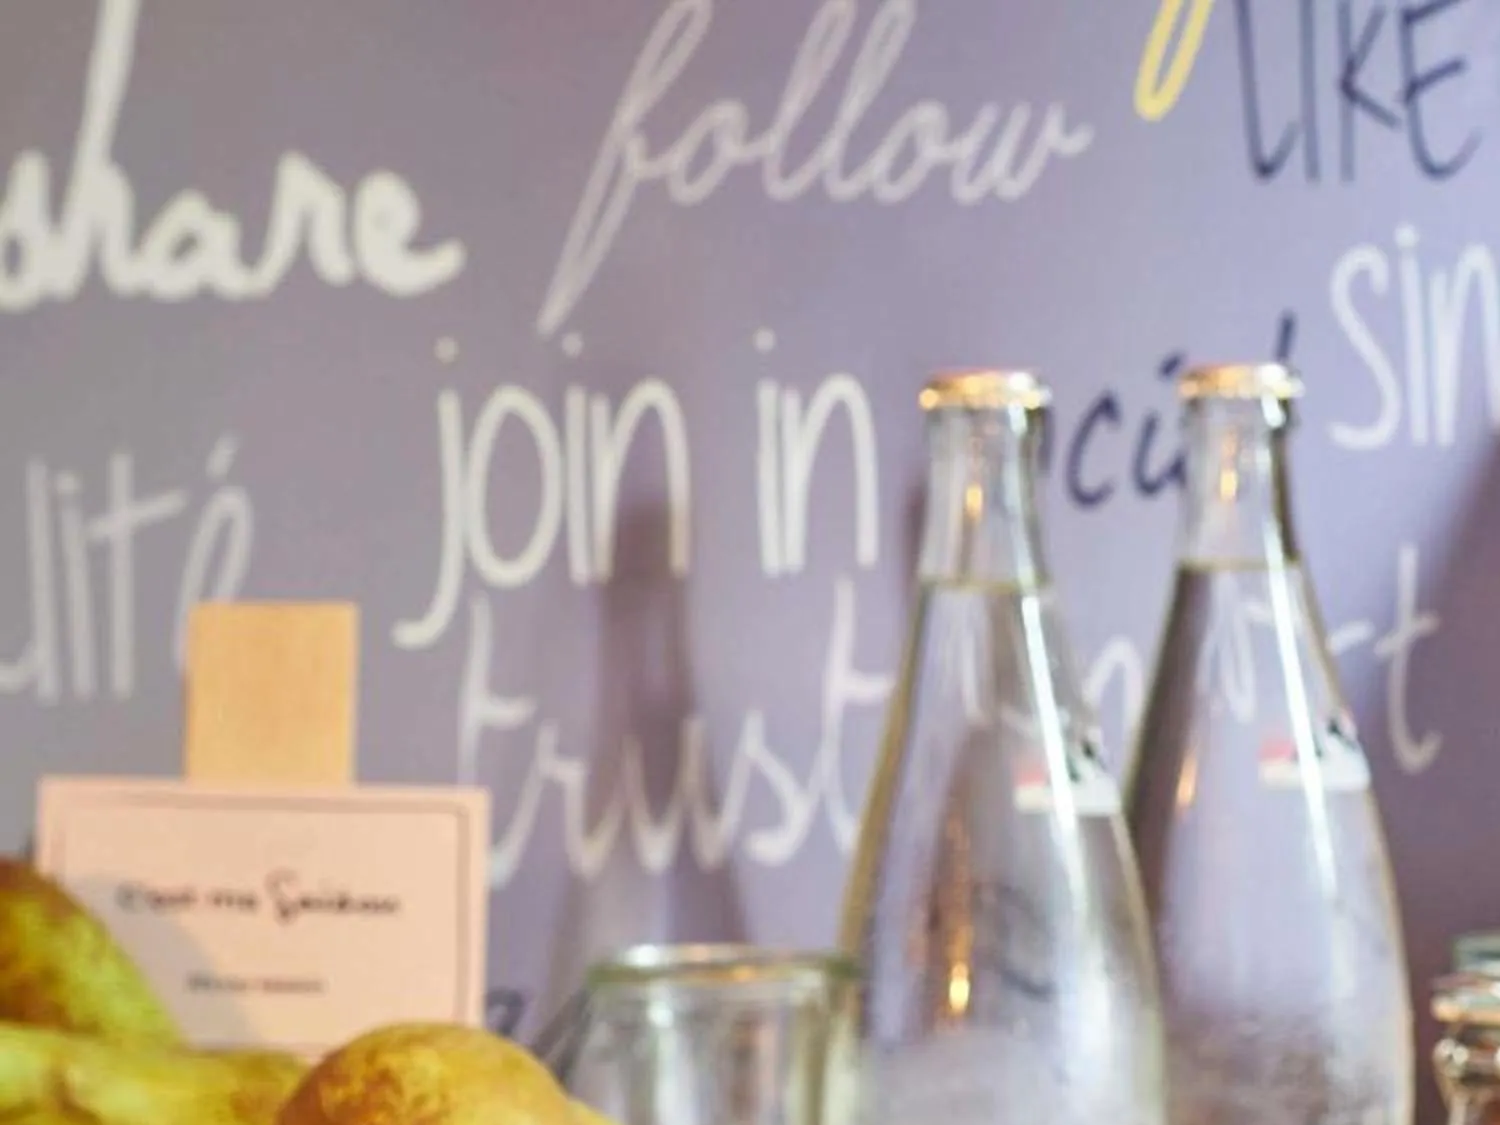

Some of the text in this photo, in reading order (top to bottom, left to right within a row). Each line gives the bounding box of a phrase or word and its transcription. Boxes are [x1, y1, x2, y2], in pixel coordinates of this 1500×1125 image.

[0, 0, 467, 313] share
[537, 0, 1094, 337] follow
[1233, 0, 1485, 184] LIKE
[392, 325, 690, 648] join
[754, 326, 882, 577] in
[458, 575, 900, 892] trust
